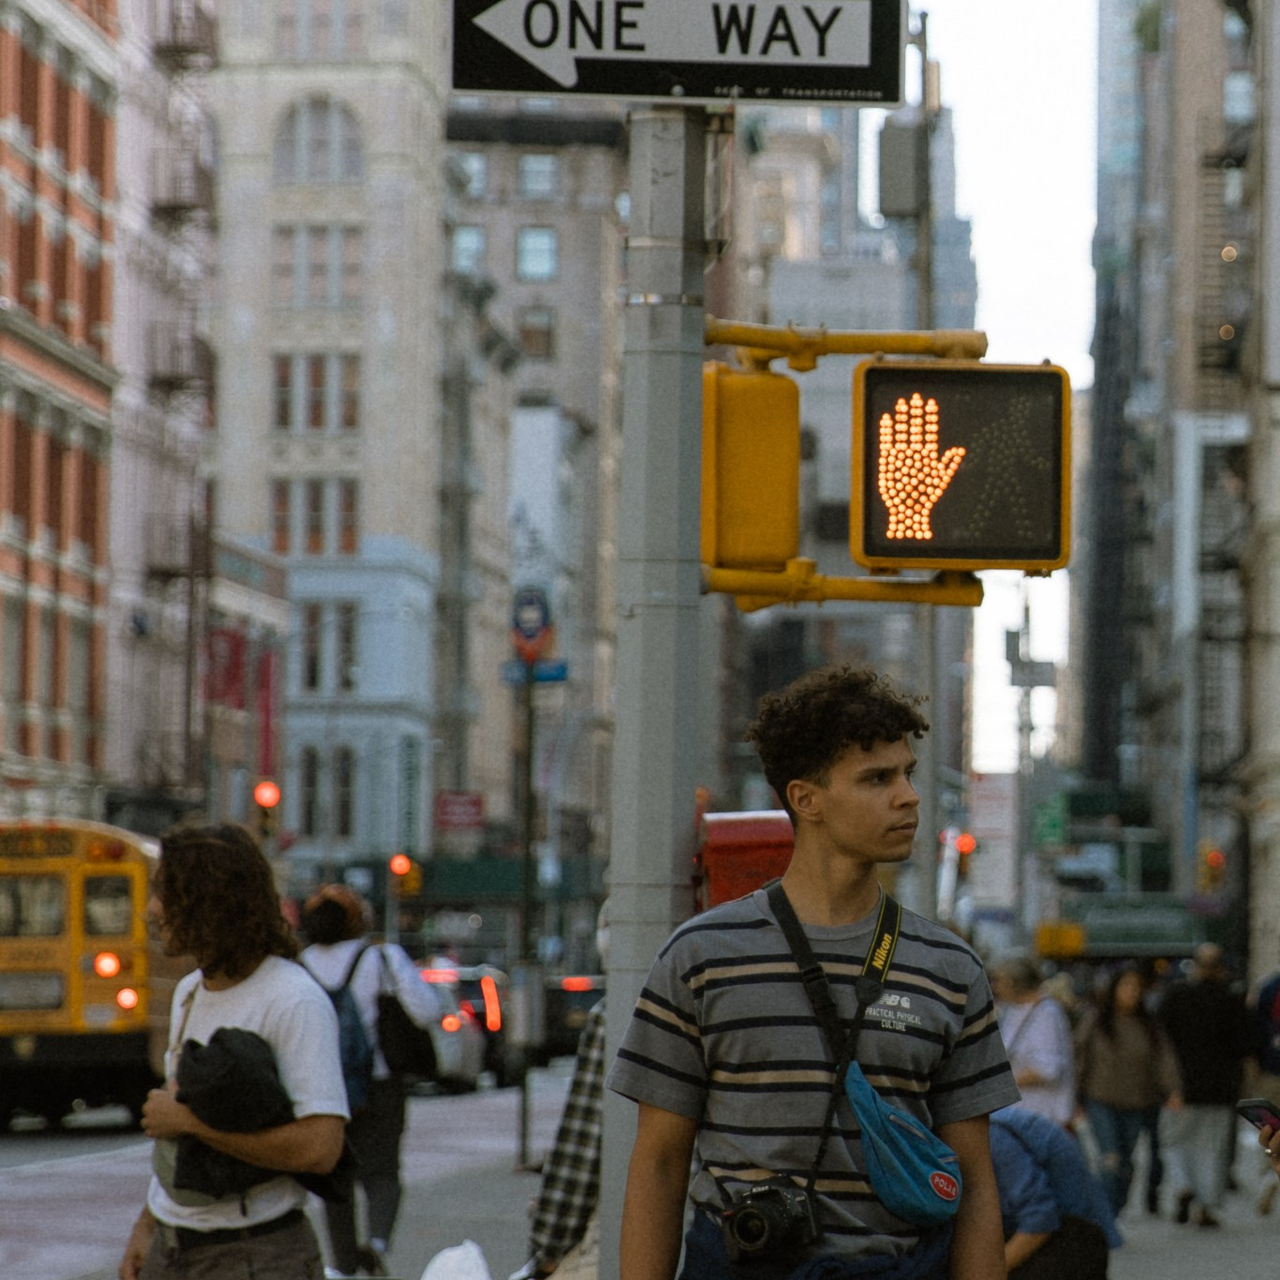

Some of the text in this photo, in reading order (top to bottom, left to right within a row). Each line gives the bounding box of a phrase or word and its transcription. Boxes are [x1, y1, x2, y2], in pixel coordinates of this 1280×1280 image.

[711, 3, 843, 58] WAY
[871, 932, 893, 970] Nikon
[865, 1007, 922, 1025] PRACTICAL PHYSICAL
[881, 1018, 906, 1032] CULTURE
